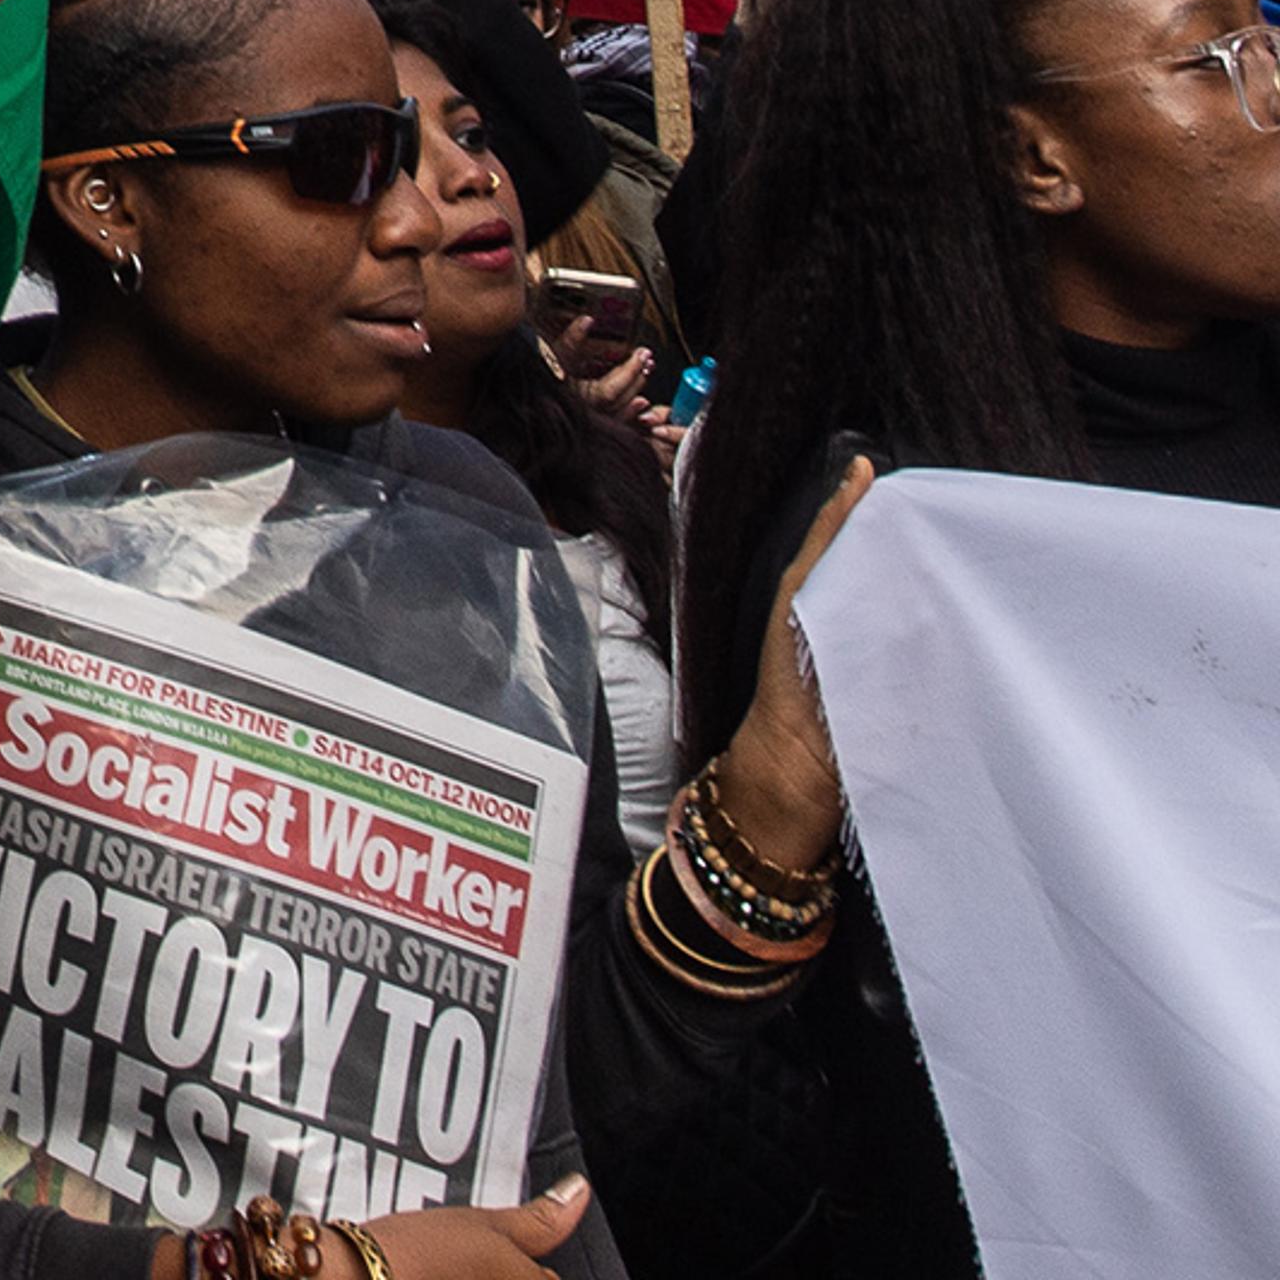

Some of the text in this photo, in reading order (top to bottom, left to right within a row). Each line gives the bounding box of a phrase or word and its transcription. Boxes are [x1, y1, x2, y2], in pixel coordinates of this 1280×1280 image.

[11, 635, 102, 682] MARCH
[105, 667, 157, 697] FOR
[158, 682, 289, 742] PALESTINE
[312, 734, 359, 769] SAT
[358, 750, 385, 777] 14
[440, 780, 466, 806] 12
[467, 790, 533, 831] NOON
[84, 830, 239, 924] ISRAELI
[244, 878, 391, 976] TERROR
[397, 934, 502, 1014] STATE
[304, 783, 525, 938] Worker
[371, 989, 489, 1167] TO
